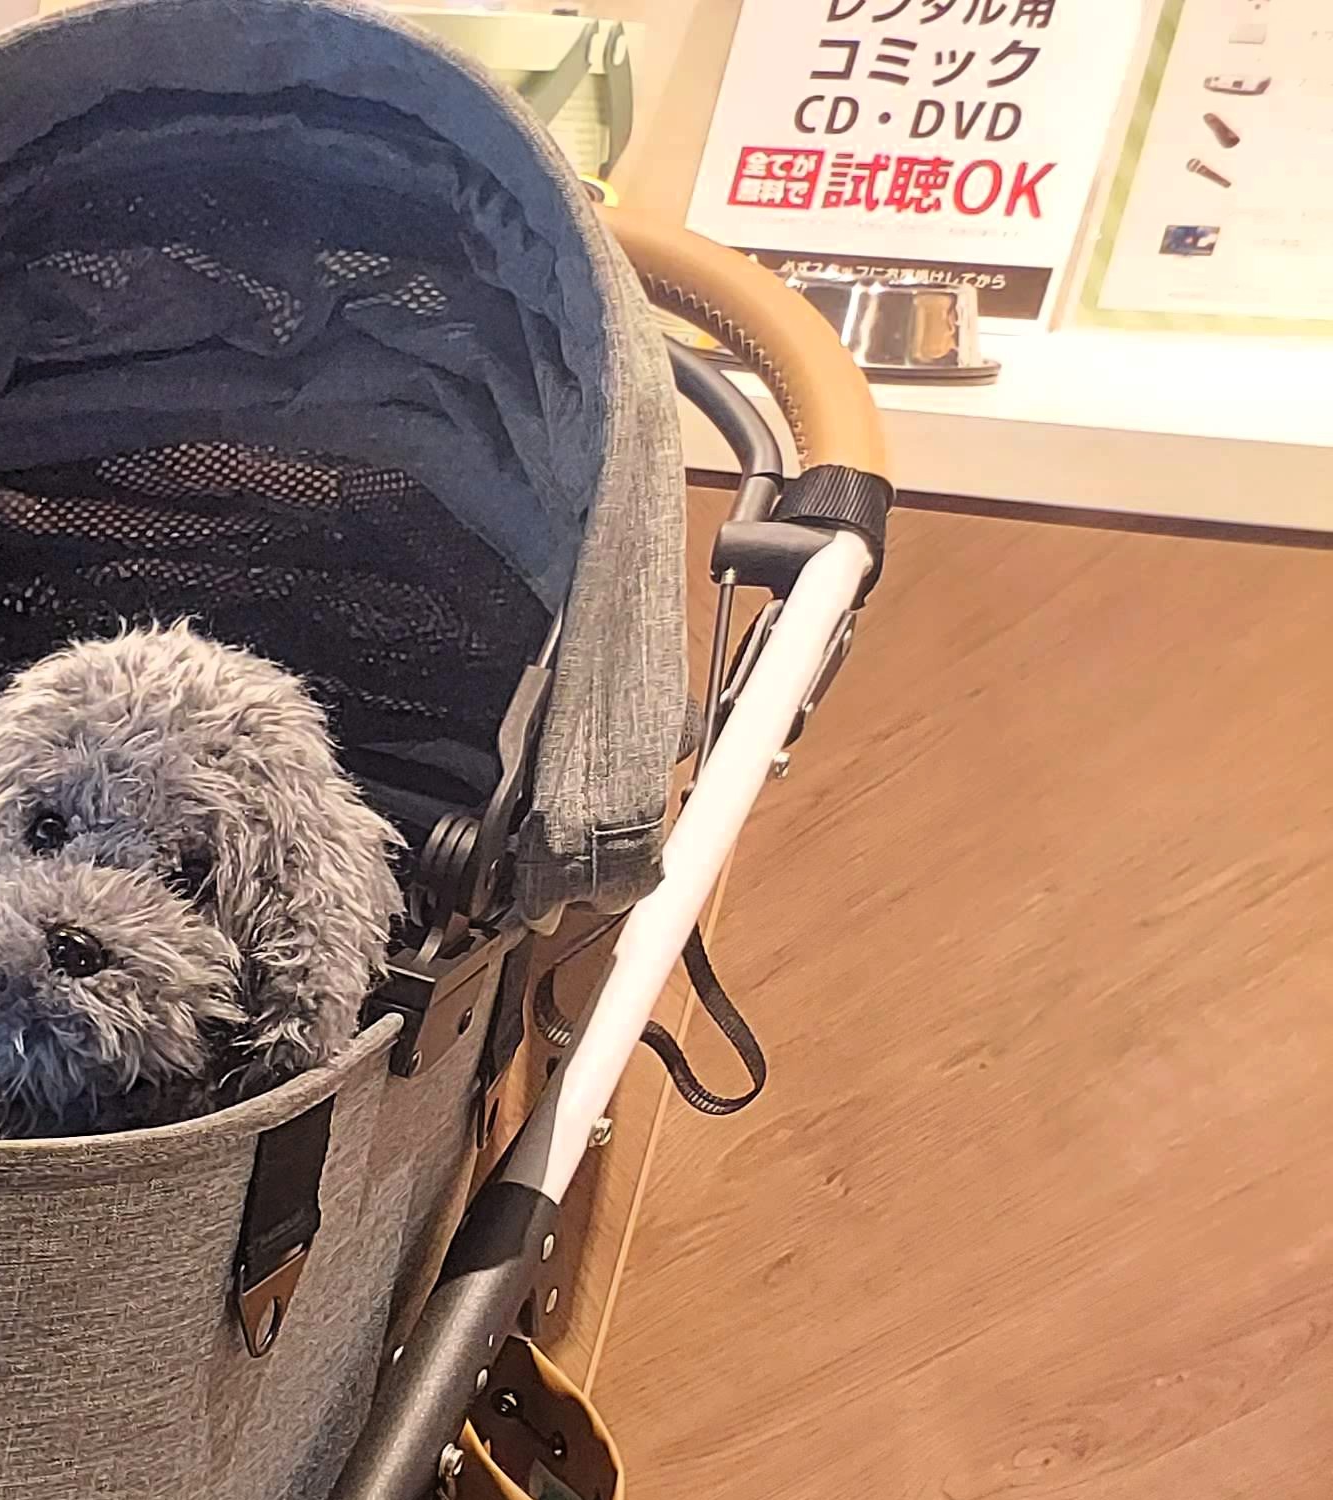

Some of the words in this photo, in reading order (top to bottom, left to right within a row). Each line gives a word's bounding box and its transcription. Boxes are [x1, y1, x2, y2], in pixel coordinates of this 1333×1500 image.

[810, 37, 1041, 88] コミック
[741, 151, 819, 178] 全てが
[821, 152, 1058, 219] 試聴OK
